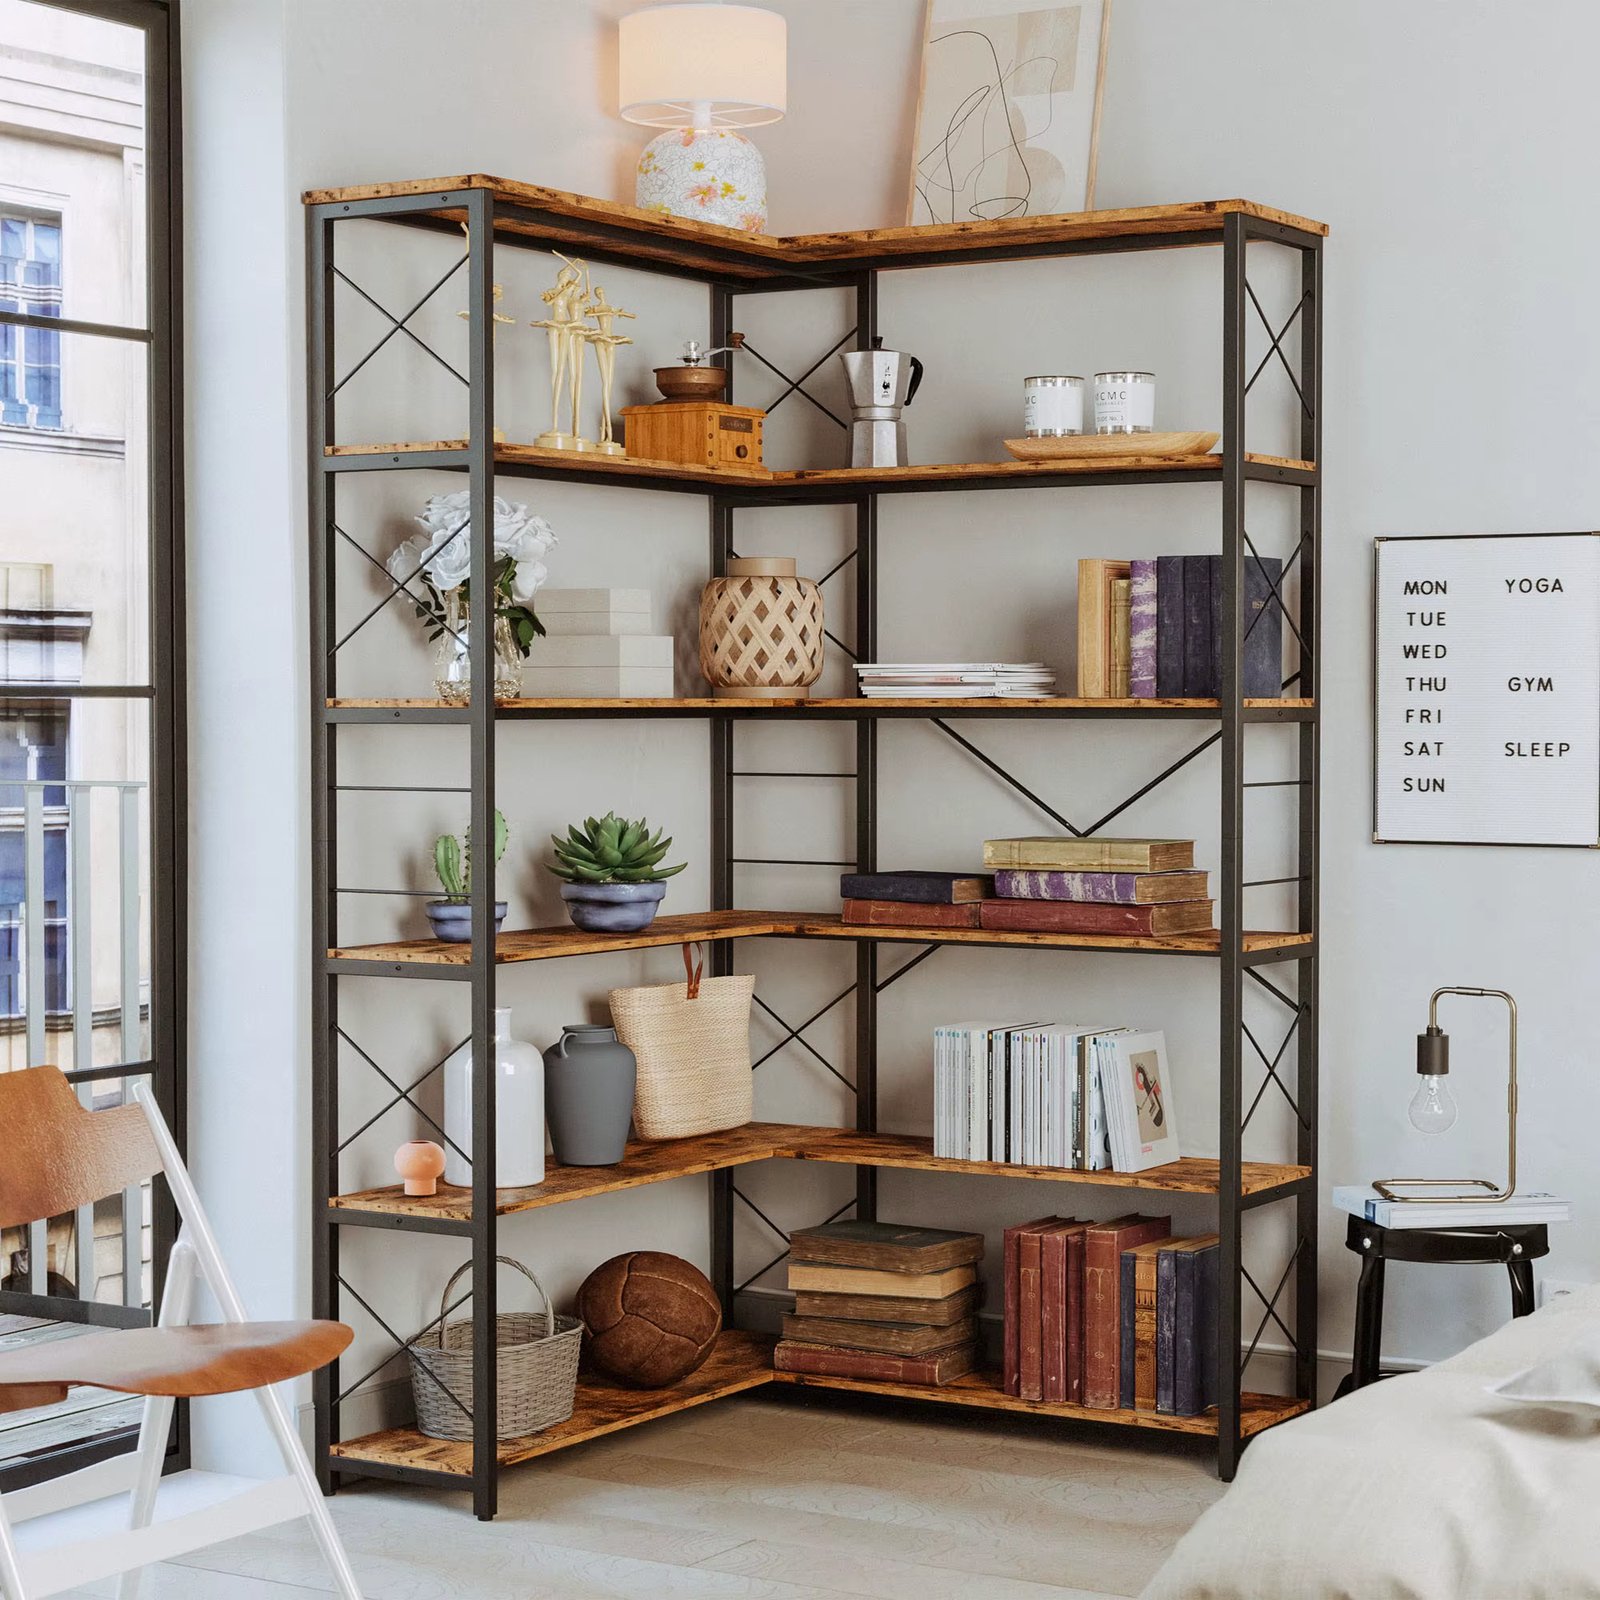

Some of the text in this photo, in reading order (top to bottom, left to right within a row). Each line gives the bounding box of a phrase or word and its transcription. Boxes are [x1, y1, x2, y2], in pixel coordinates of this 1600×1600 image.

[1404, 581, 1447, 595] MON
[1505, 578, 1563, 593] YOGA
[1407, 612, 1446, 626] TUE
[1403, 645, 1447, 659] WED
[1406, 677, 1446, 691] THU
[1508, 677, 1553, 691] GYM
[1406, 709, 1441, 723] FRI
[1404, 742, 1443, 756] SAT
[1505, 742, 1570, 757] SLEEP
[1404, 778, 1444, 792] SUN
